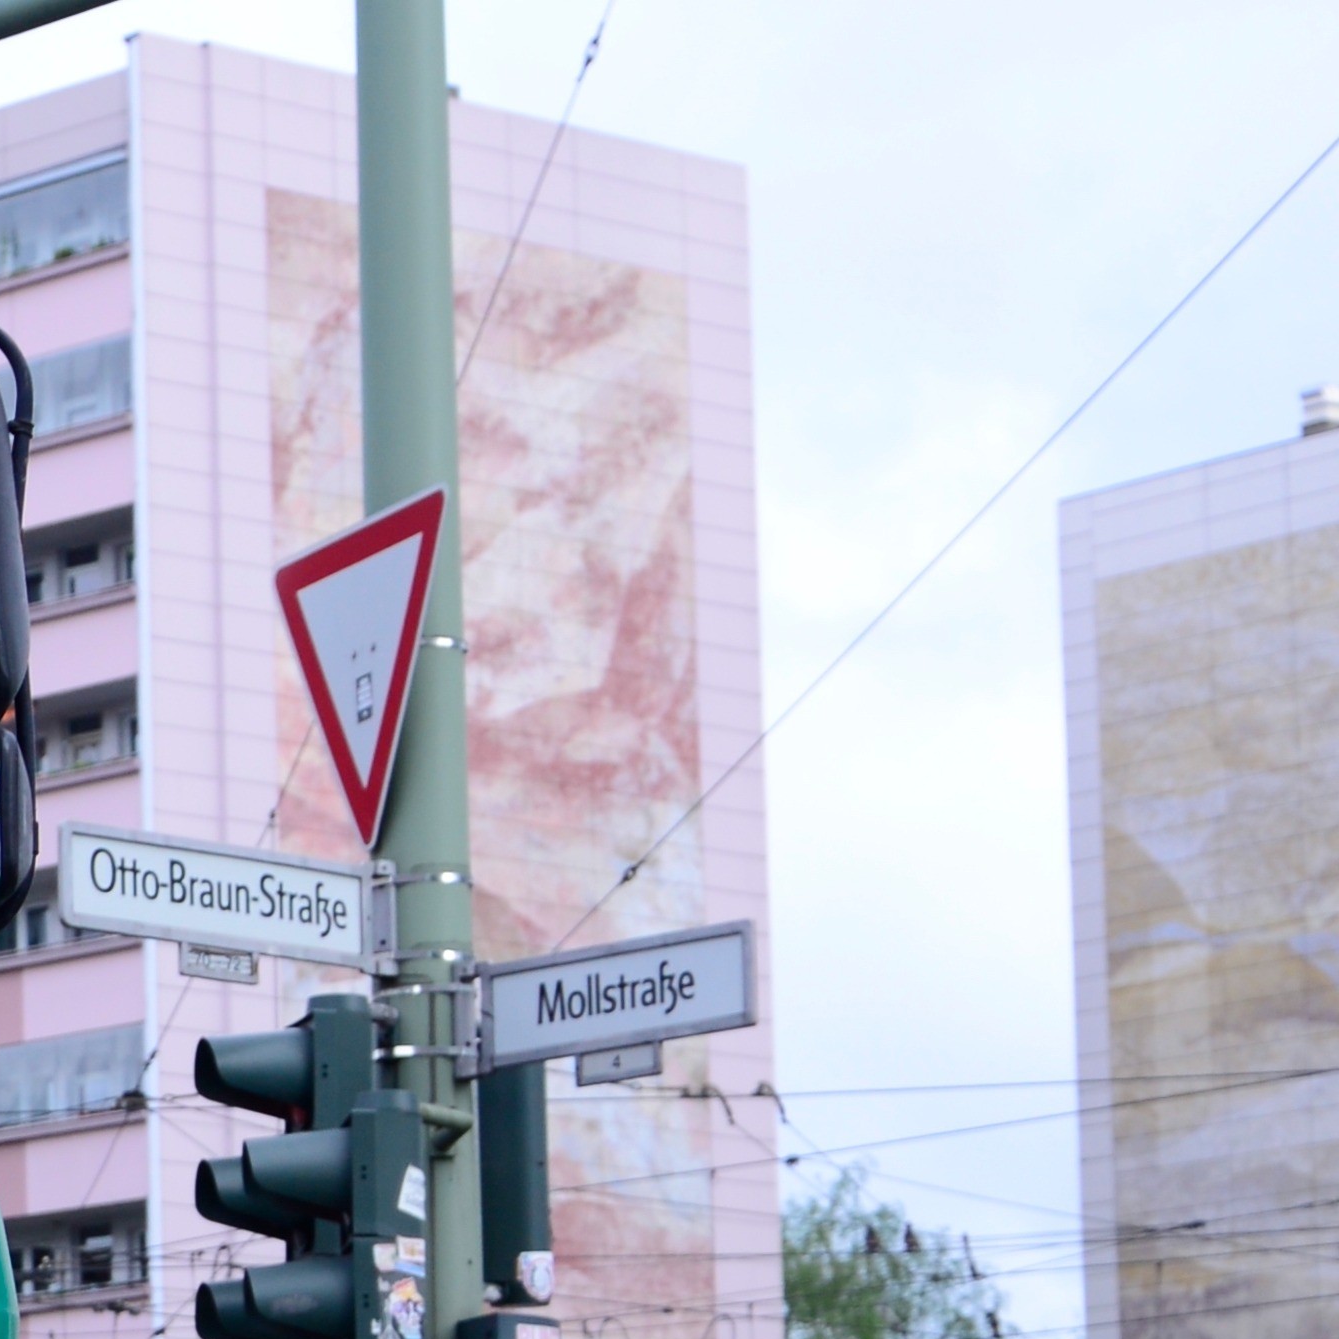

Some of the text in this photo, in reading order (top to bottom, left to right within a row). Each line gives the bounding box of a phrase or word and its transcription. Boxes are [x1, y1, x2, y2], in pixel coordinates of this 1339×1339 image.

[89, 848, 347, 938] Otto-Braun-Straße
[536, 960, 696, 1026] Mollstraße
[612, 1054, 621, 1068] 4
